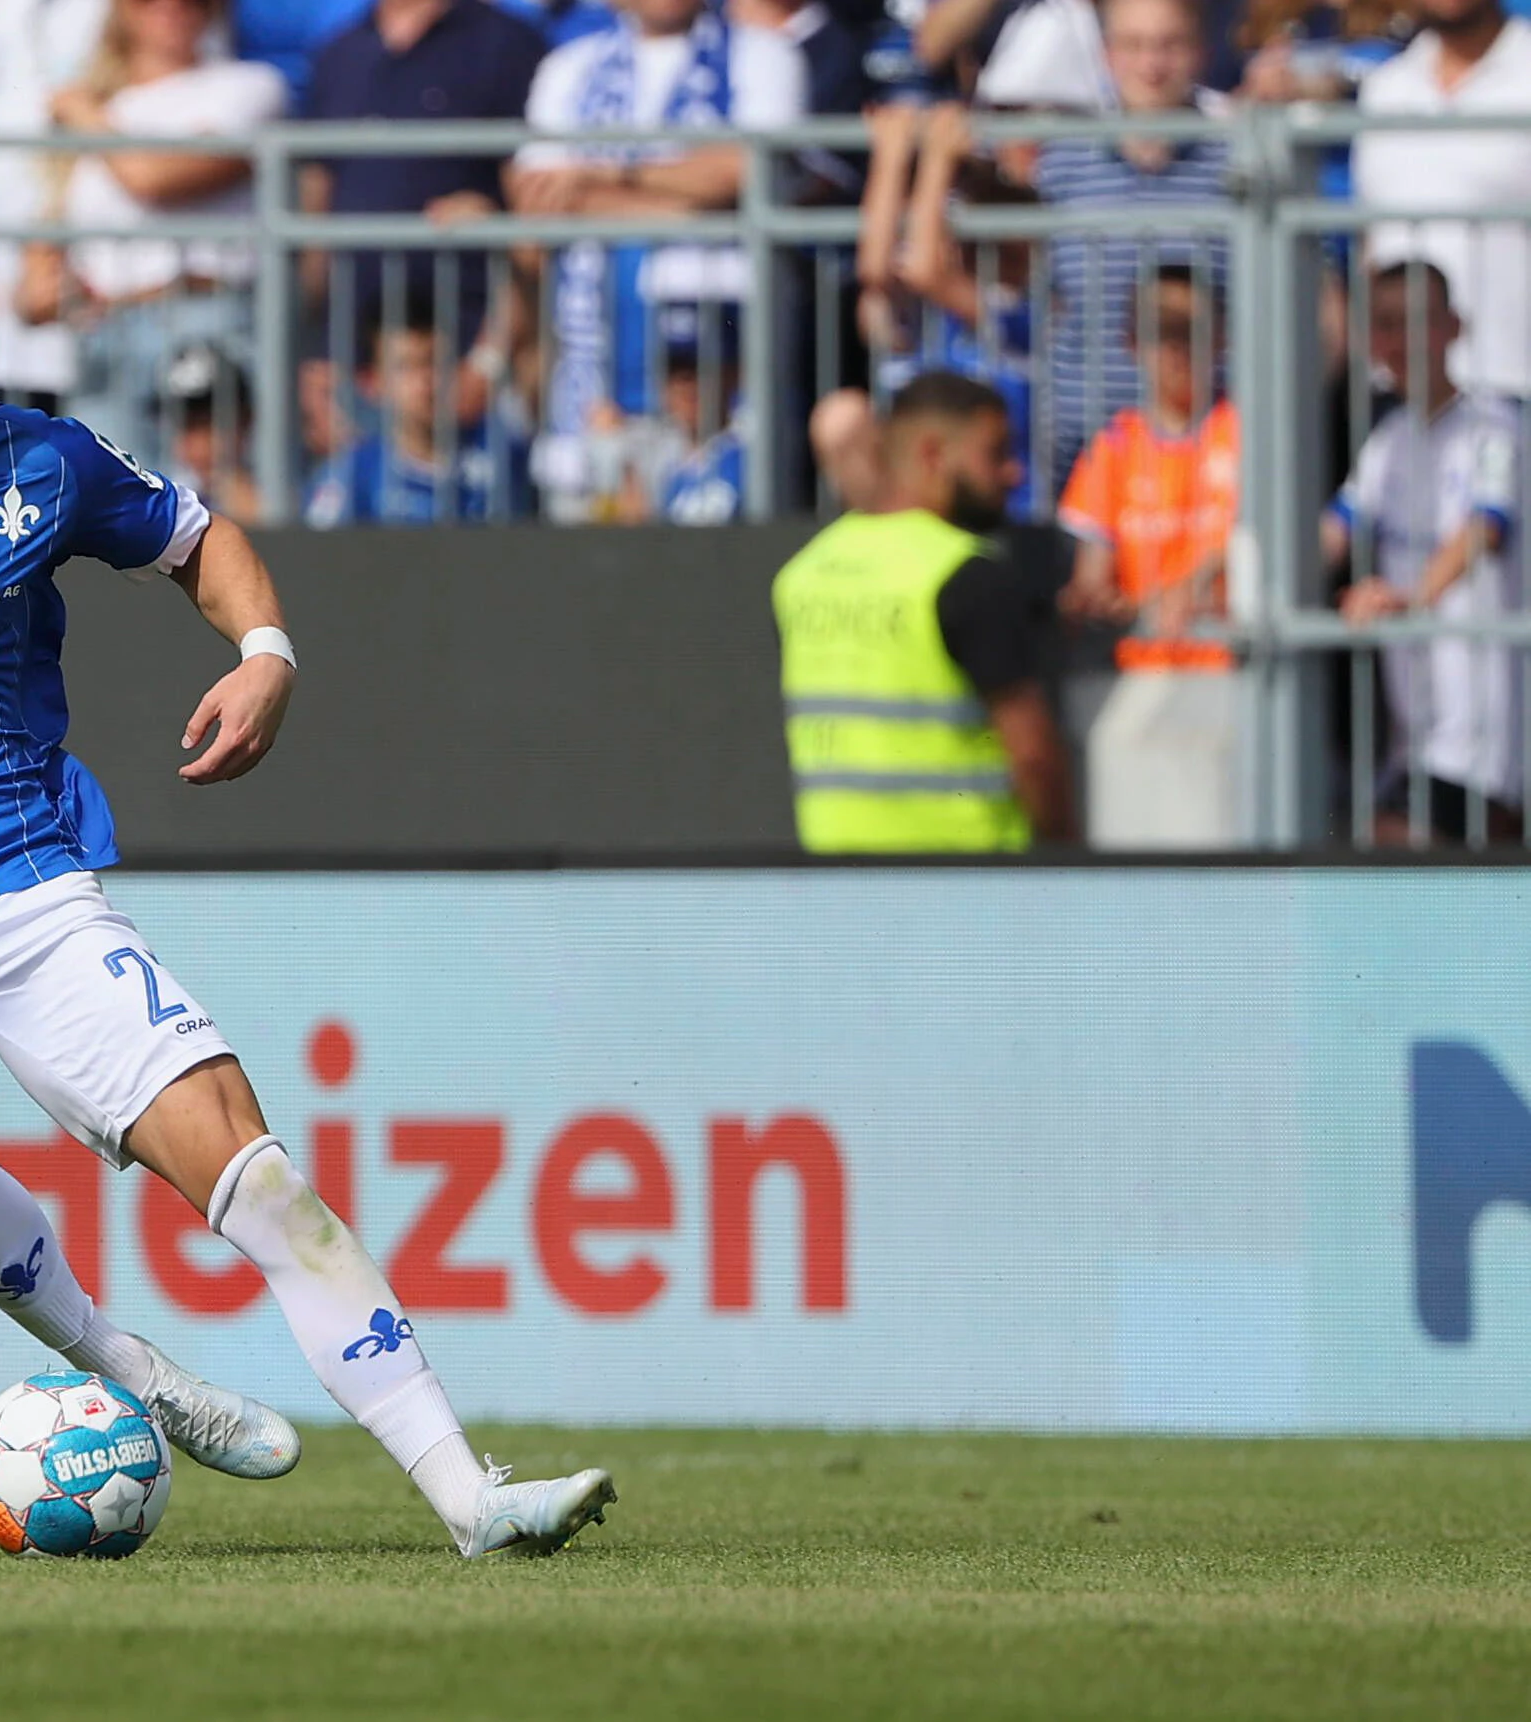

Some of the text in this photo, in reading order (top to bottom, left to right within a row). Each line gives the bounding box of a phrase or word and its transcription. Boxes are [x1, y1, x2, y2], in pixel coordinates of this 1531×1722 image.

[3, 584, 21, 599] AG
[102, 946, 189, 1028] 2
[52, 1437, 158, 1483] DERBYSTAR
